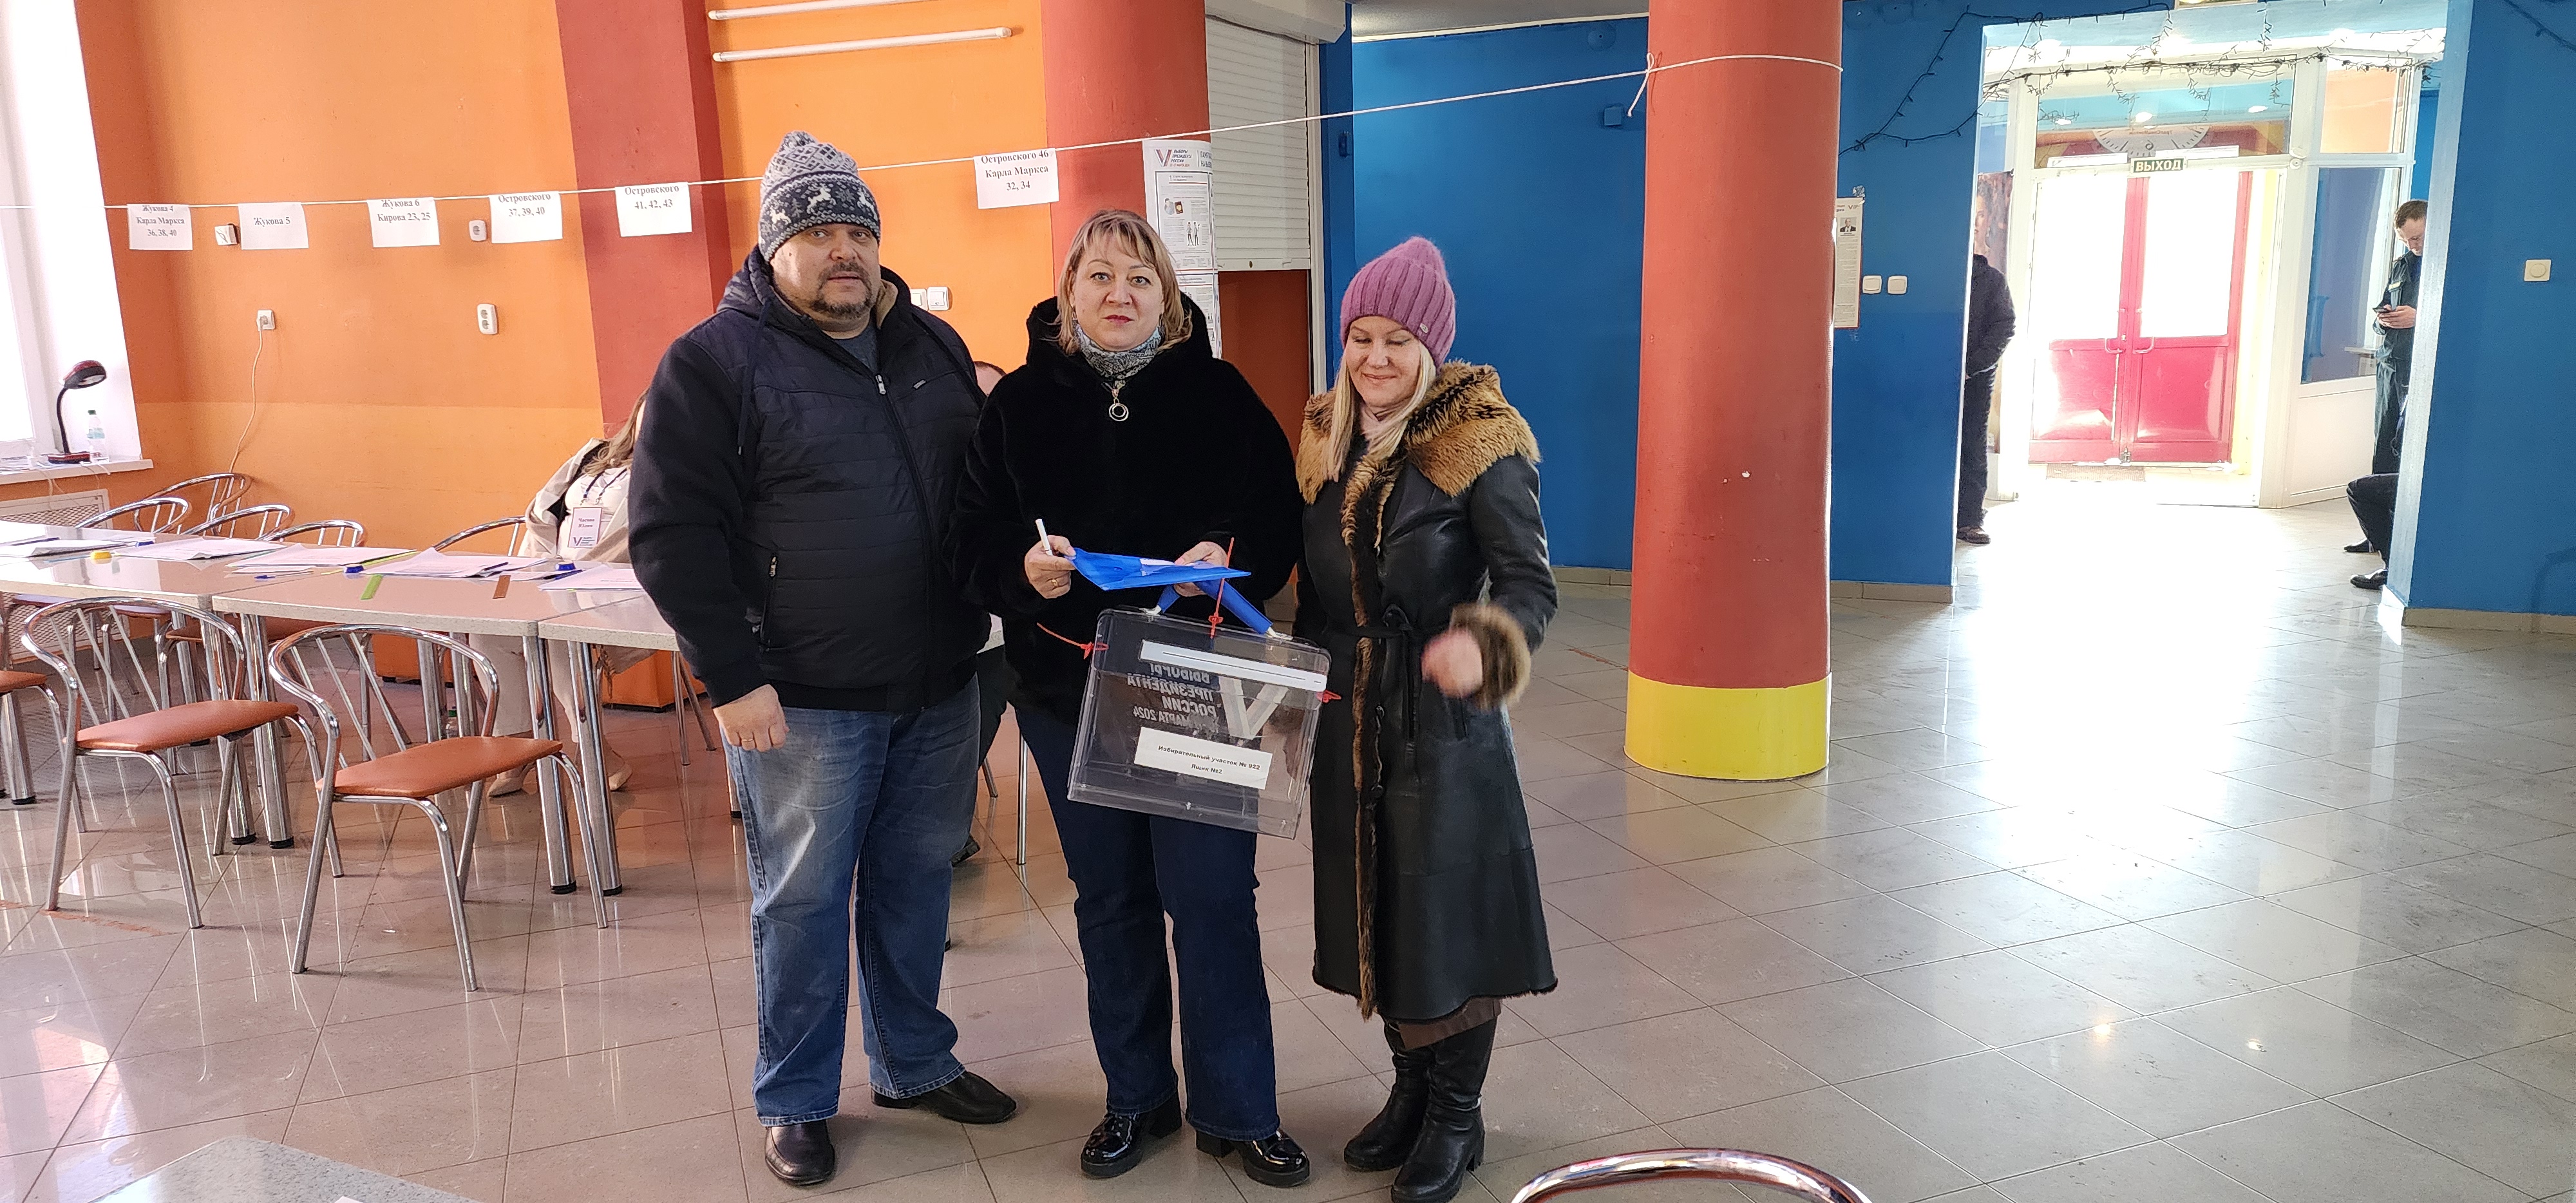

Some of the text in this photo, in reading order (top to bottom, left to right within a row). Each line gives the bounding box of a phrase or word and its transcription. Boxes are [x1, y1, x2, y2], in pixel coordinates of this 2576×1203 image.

[981, 149, 1049, 164] Островского 46
[2136, 160, 2181, 172] ВЫХОД
[985, 166, 1049, 179] Карла Маркса
[624, 185, 679, 196] Островского
[1006, 180, 1030, 191] 32, 34
[381, 198, 420, 209] Жукова 6
[498, 194, 551, 204] Островского
[634, 198, 673, 210] 41, 42, 43
[142, 205, 168, 214] Жукова
[509, 206, 545, 217] 37, 39, 40
[136, 216, 185, 225] Карла Маркса
[253, 216, 291, 227] Жукова 5
[377, 212, 431, 223] Кирова 23, 25
[158, 229, 169, 237] 38,
[1158, 745, 1210, 761] Избирательный
[1211, 757, 1238, 766] участок
[1191, 764, 1209, 772] Ящик
